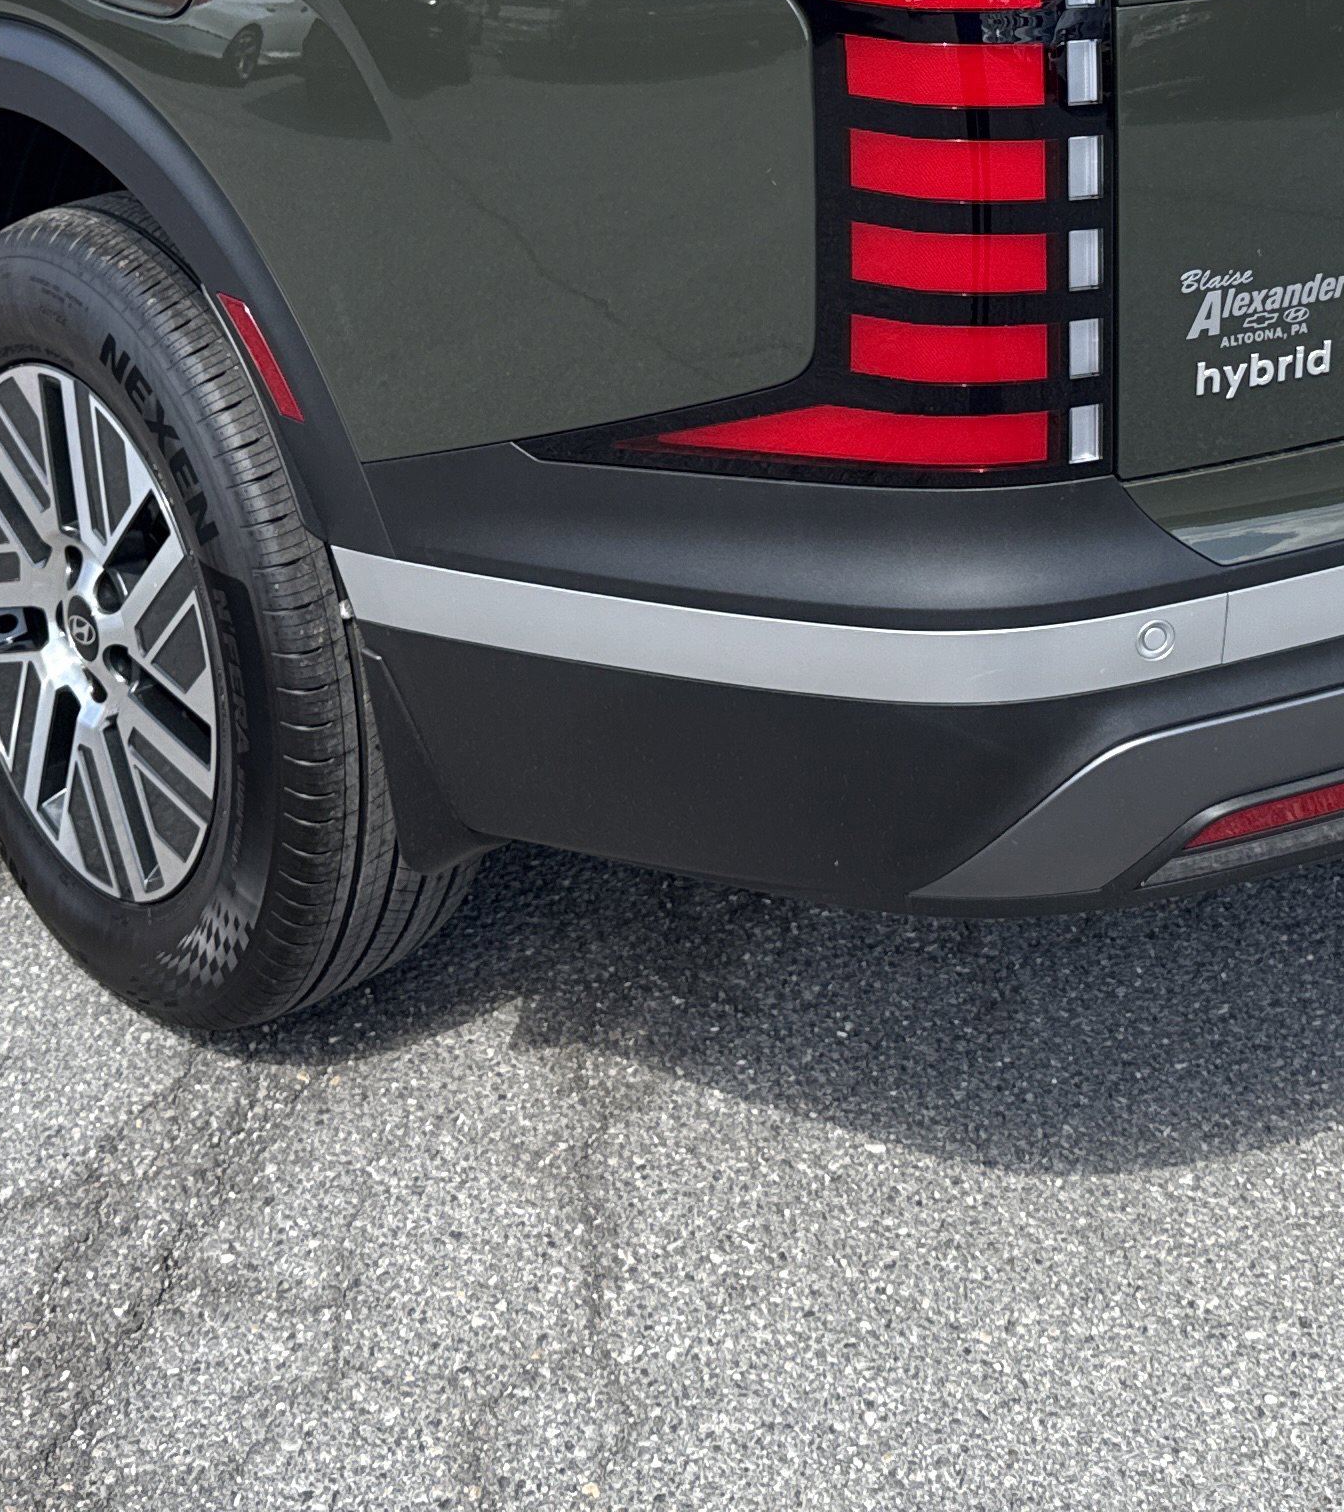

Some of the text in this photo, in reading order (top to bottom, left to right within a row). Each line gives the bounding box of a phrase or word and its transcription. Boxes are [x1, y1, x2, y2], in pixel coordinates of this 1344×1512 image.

[1179, 268, 1254, 294] Blaise
[1220, 322, 1309, 349] ALTOONA, PA
[1195, 339, 1333, 400] hybrid
[98, 332, 220, 547] NEXEN
